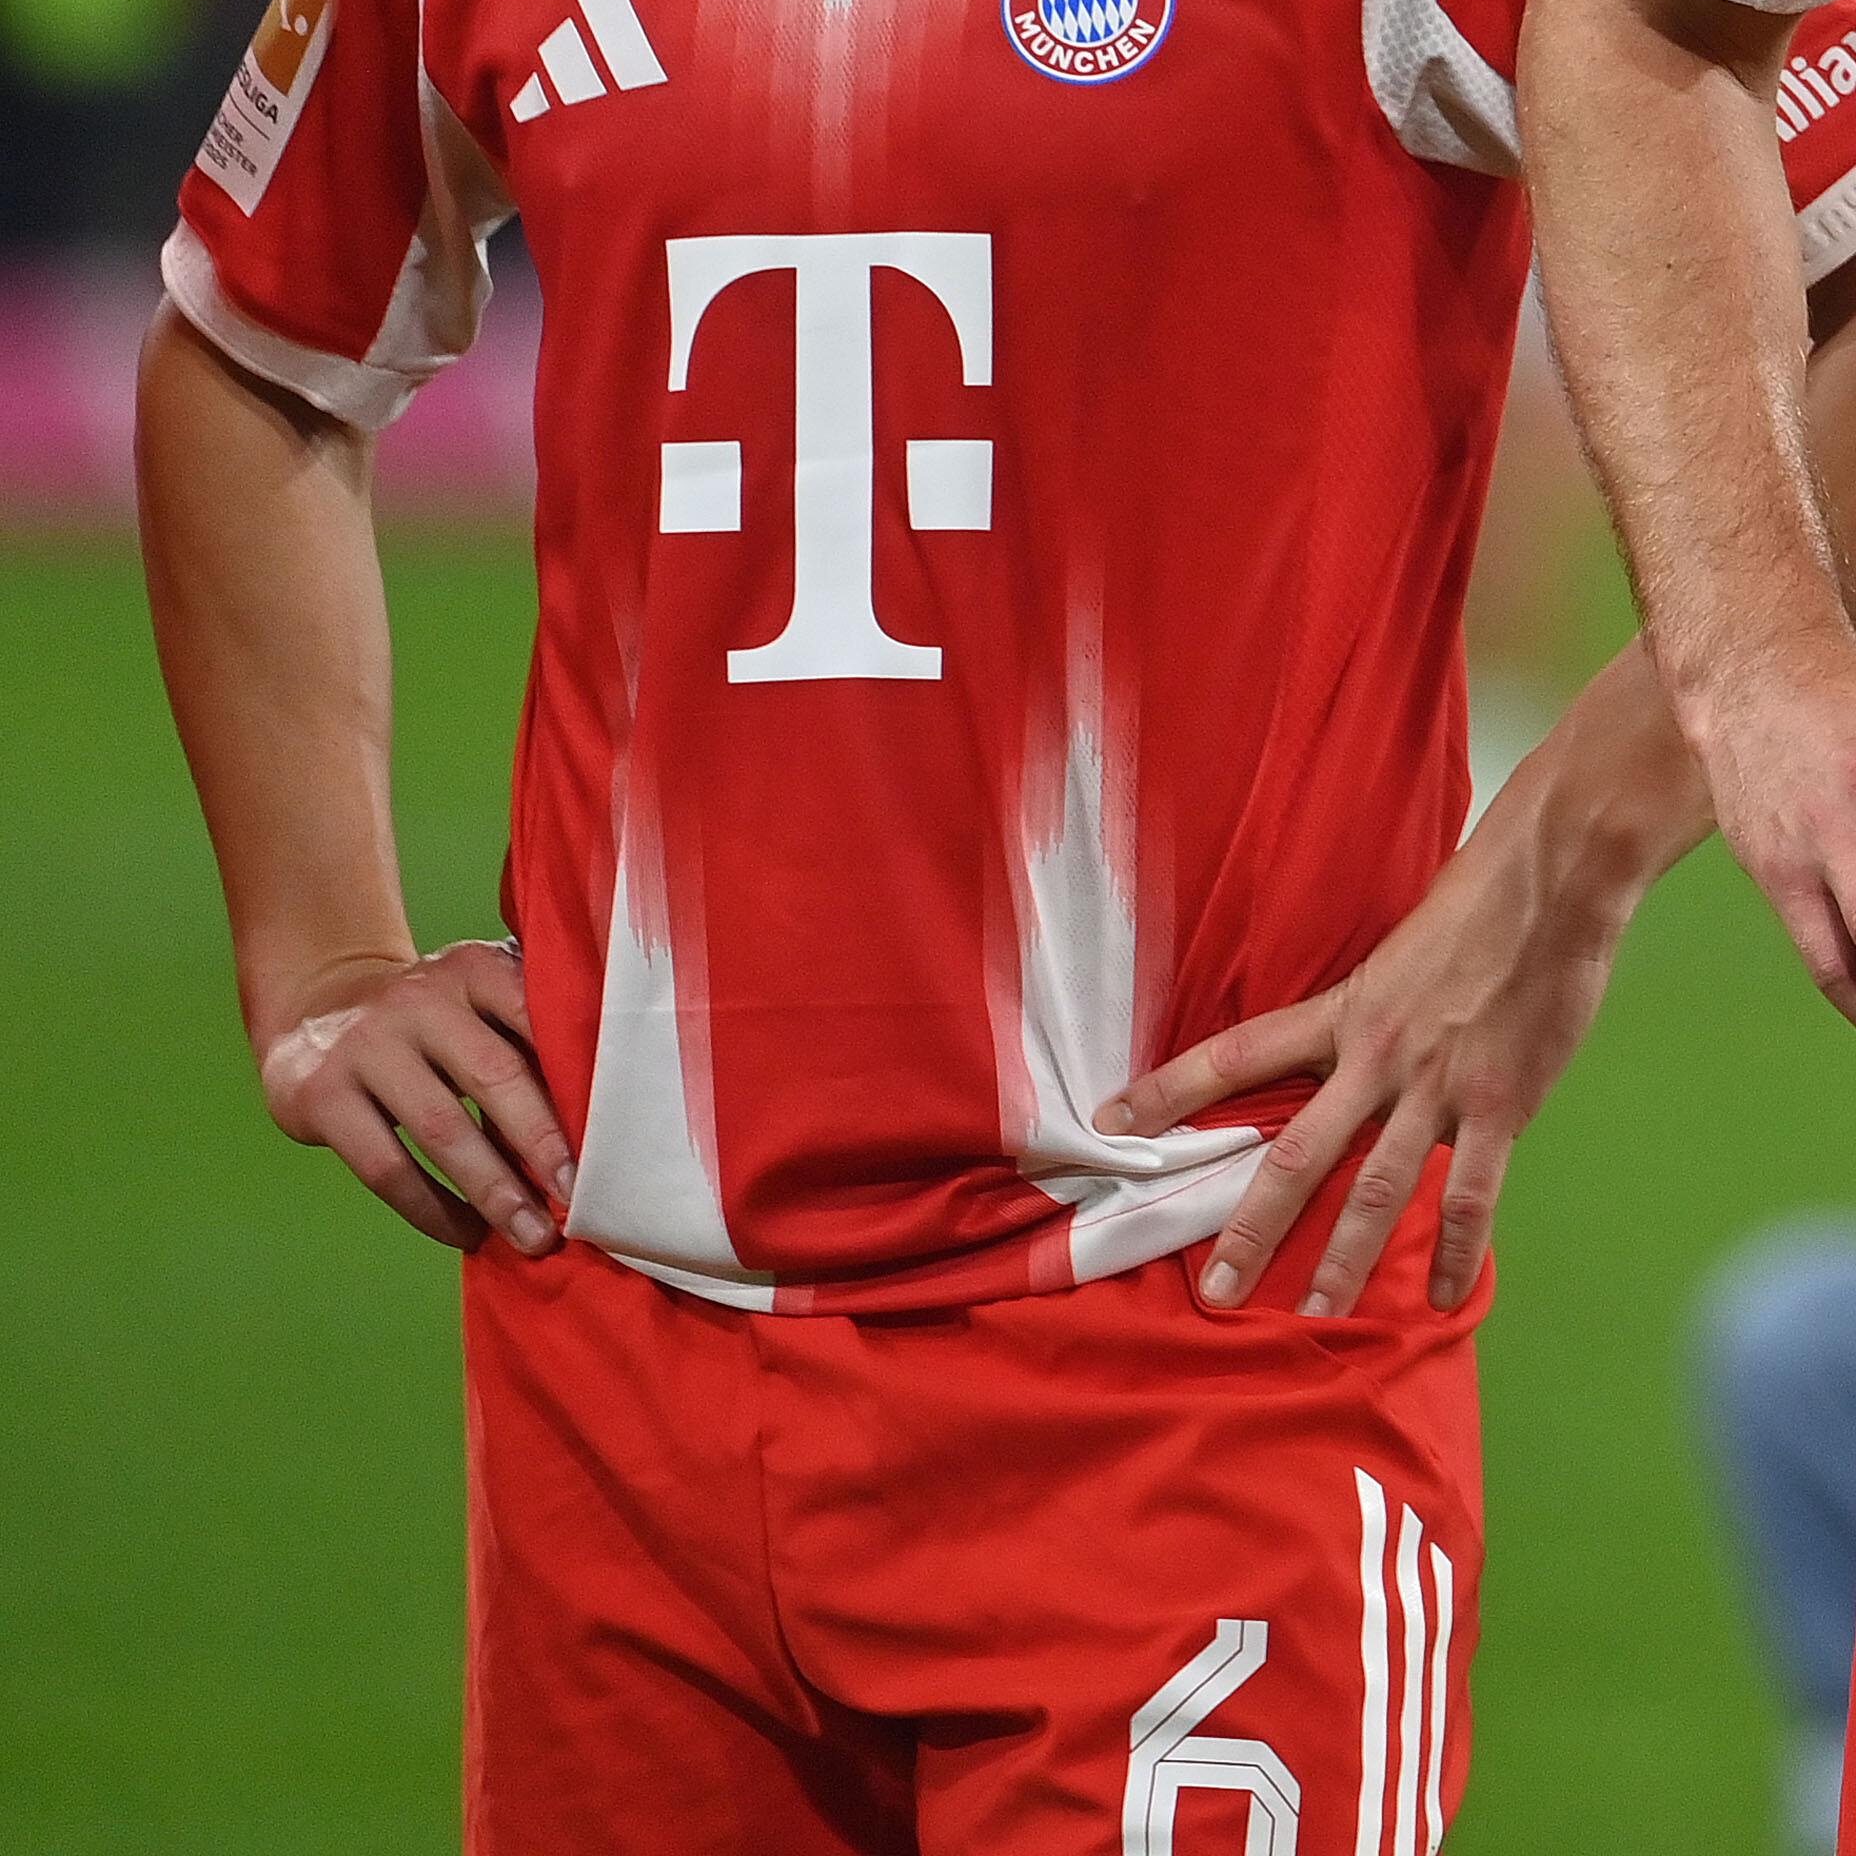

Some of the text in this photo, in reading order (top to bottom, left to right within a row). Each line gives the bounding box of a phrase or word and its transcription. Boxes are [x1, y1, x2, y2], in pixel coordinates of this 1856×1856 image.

[1015, 10, 1156, 73] MÜNCHEN
[659, 231, 994, 684] T
[1121, 1618, 1302, 1856] 6
